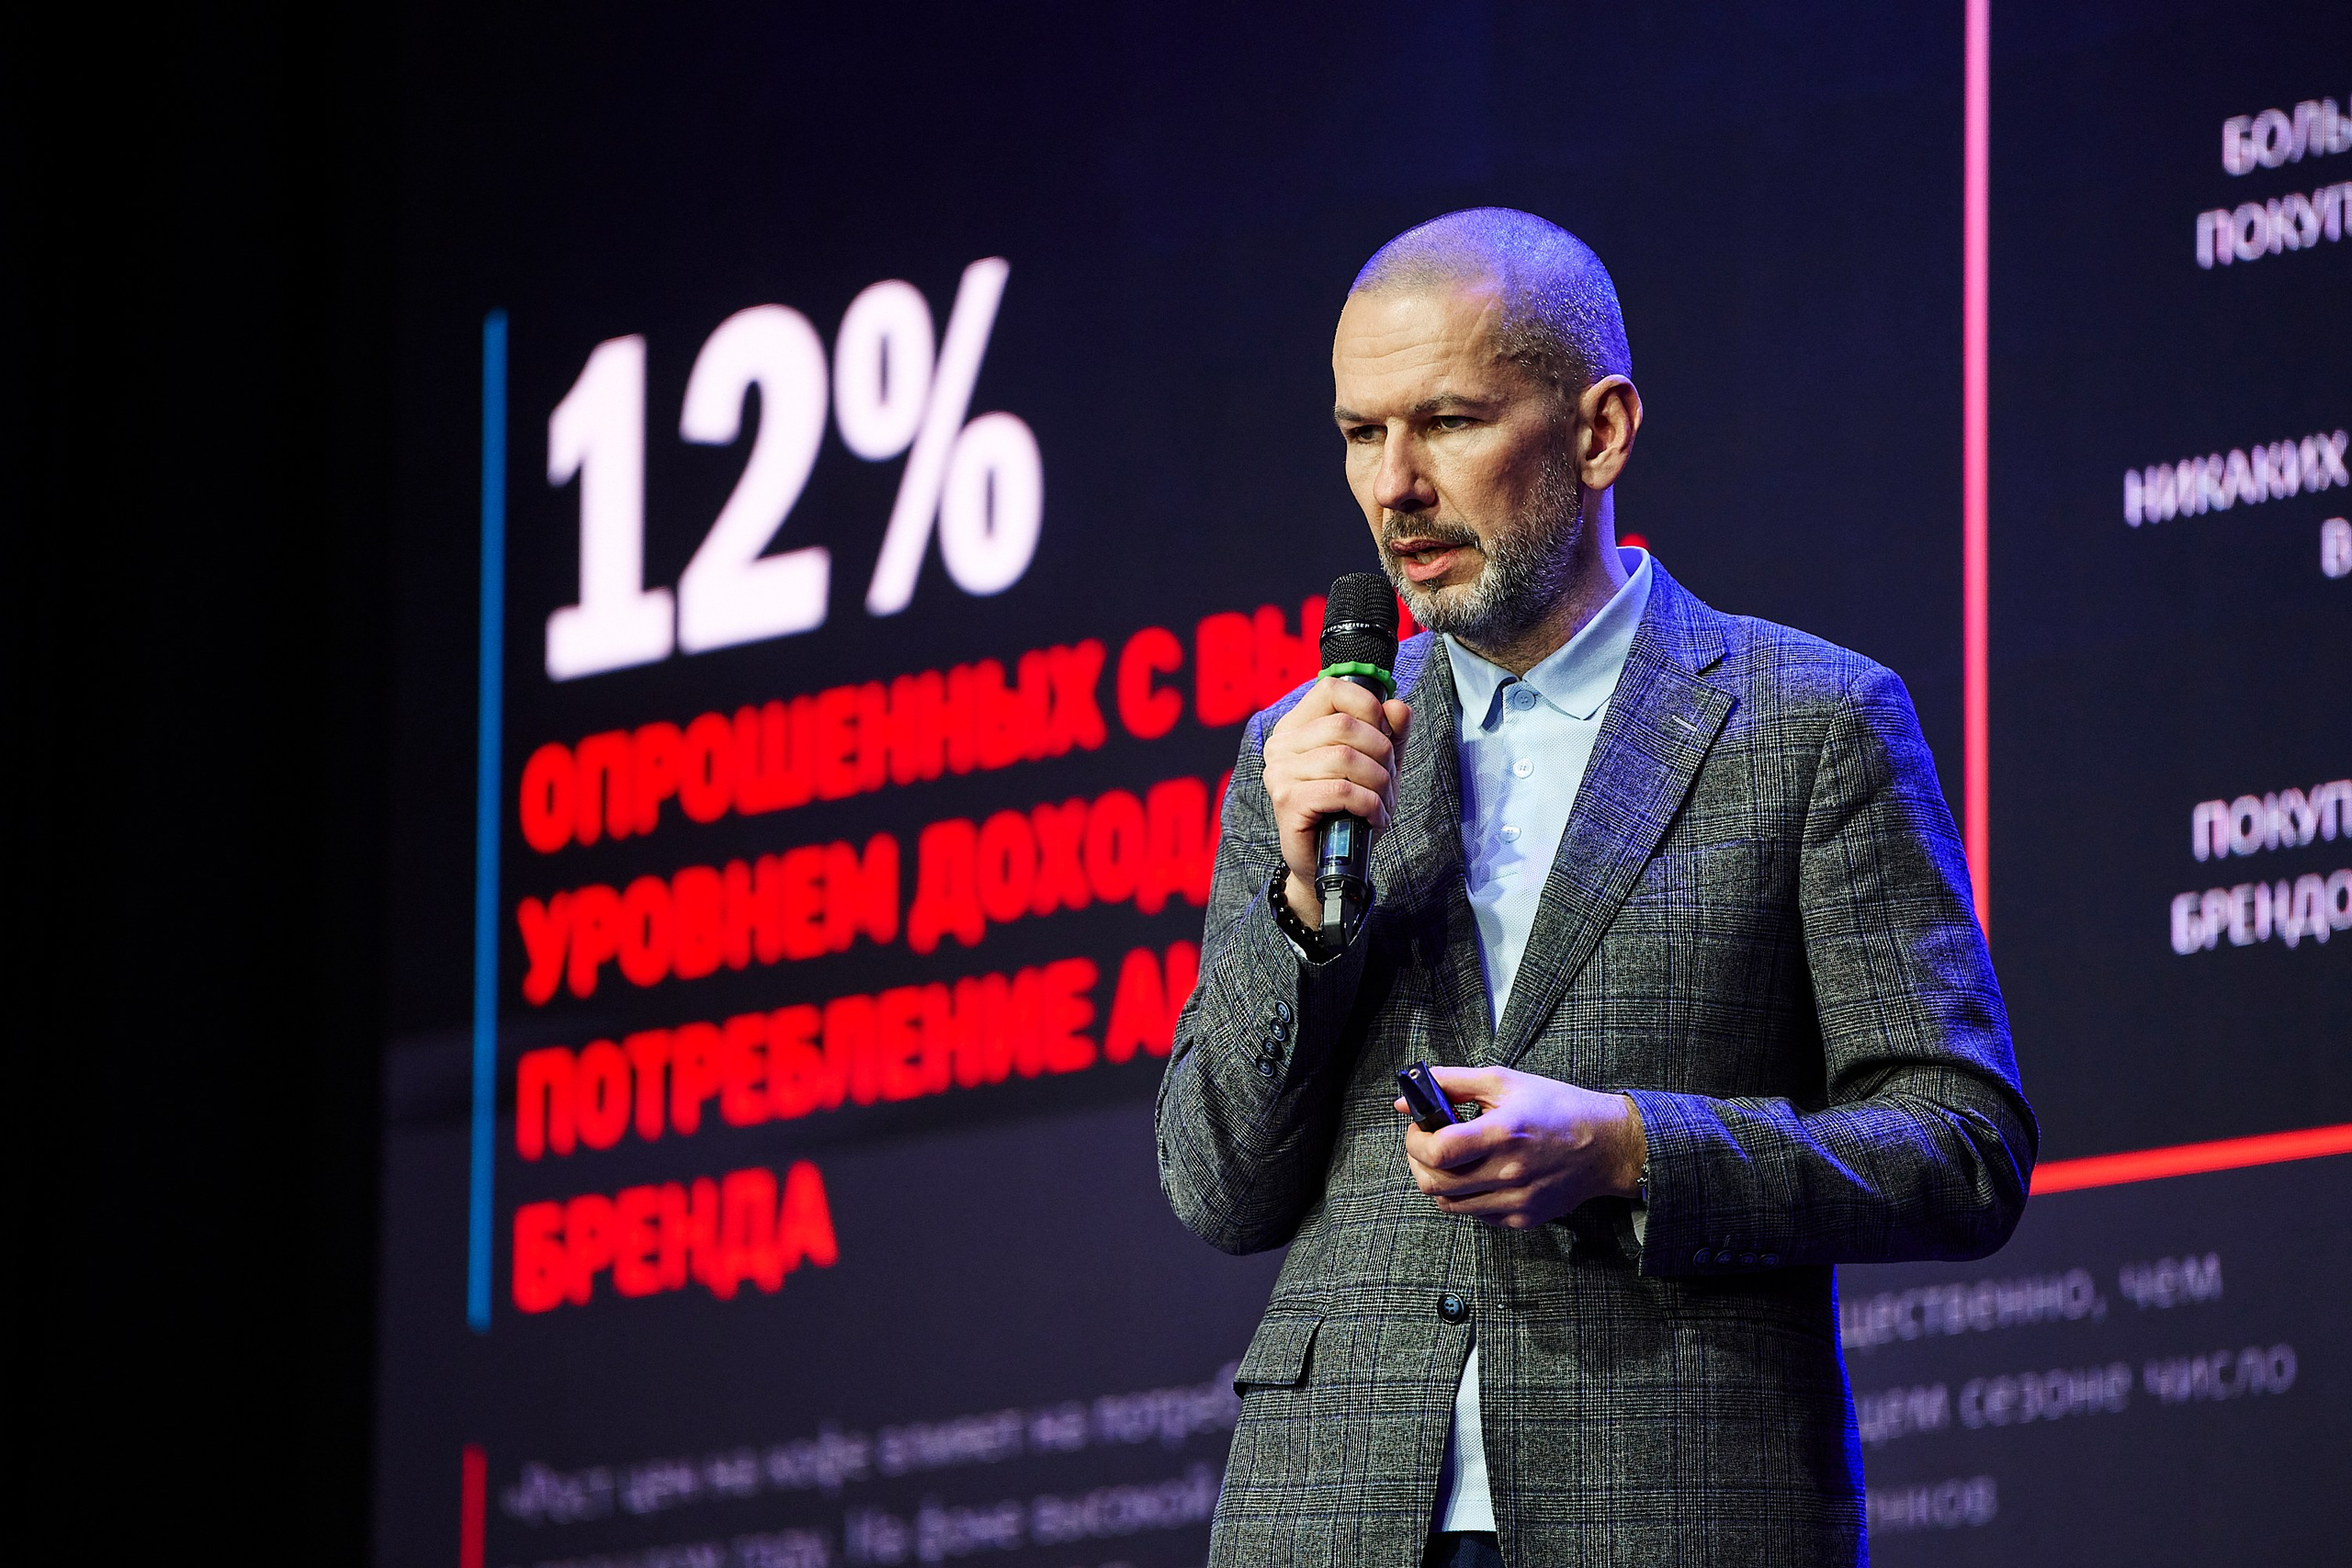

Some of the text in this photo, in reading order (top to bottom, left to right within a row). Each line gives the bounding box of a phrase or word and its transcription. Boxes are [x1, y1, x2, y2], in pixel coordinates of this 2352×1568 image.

[2222, 93, 2352, 176] БОЛЬ
[544, 255, 1045, 682] 12%
[2123, 429, 2349, 528] НИКАКИХ
[518, 638, 1107, 854] ОПРОШЕННЫХ
[1115, 626, 1183, 740] С
[516, 831, 899, 1005] УРОВНЕМ
[515, 956, 1098, 1161] ПОТРЕБЛЕНИЕ
[511, 1159, 838, 1314] БРЕНДА
